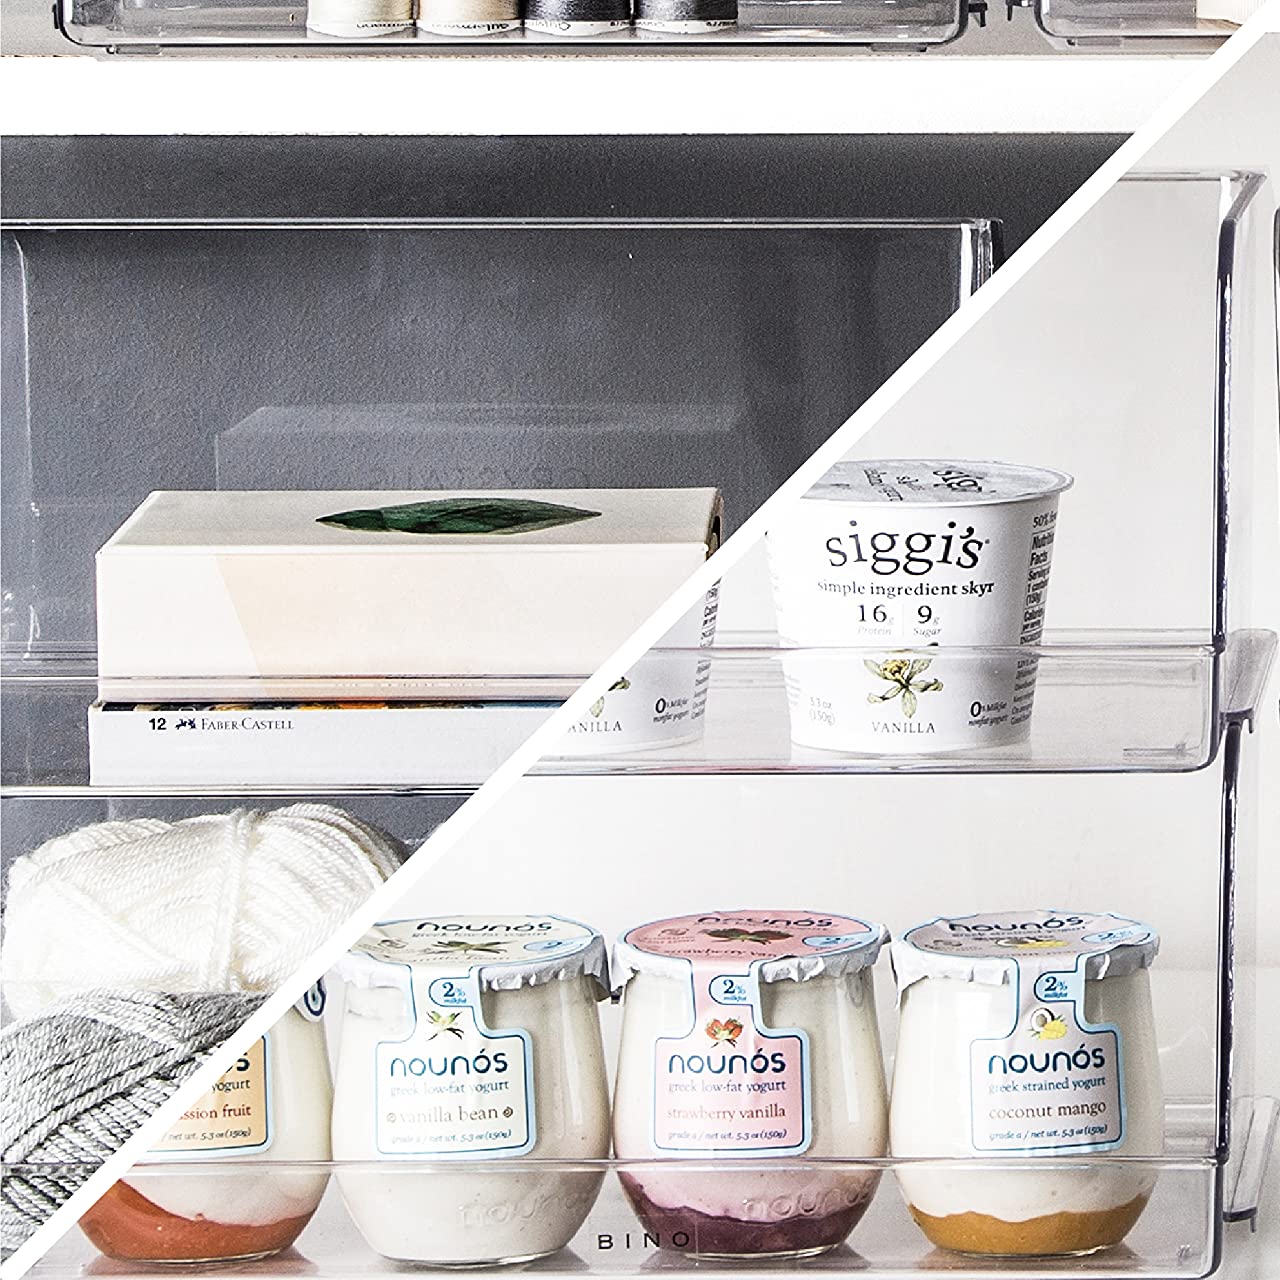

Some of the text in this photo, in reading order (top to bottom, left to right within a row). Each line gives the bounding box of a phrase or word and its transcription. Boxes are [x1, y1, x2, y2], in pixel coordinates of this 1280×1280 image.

[826, 520, 984, 576] siggi's
[817, 580, 995, 599] simple ingredient skyr
[913, 627, 942, 638] Sugar
[149, 717, 167, 730] 12
[567, 721, 622, 733] ANILLA
[872, 722, 935, 733] VANILLA
[390, 1048, 508, 1077] nounós
[668, 1047, 786, 1074] nounós
[988, 1043, 1106, 1074] nounós
[212, 1080, 251, 1094] yogurt
[469, 1080, 510, 1094] yogurt
[701, 1079, 742, 1093] low-fat
[746, 1080, 787, 1095] yogurt
[1022, 1077, 1070, 1092] strained
[1071, 1076, 1107, 1091] yogurt
[180, 1104, 252, 1120] ssion fruit
[458, 1106, 499, 1121] bean
[739, 1102, 787, 1119] vanilla
[989, 1101, 1107, 1119] coconut mango
[598, 1232, 690, 1251] BINO
